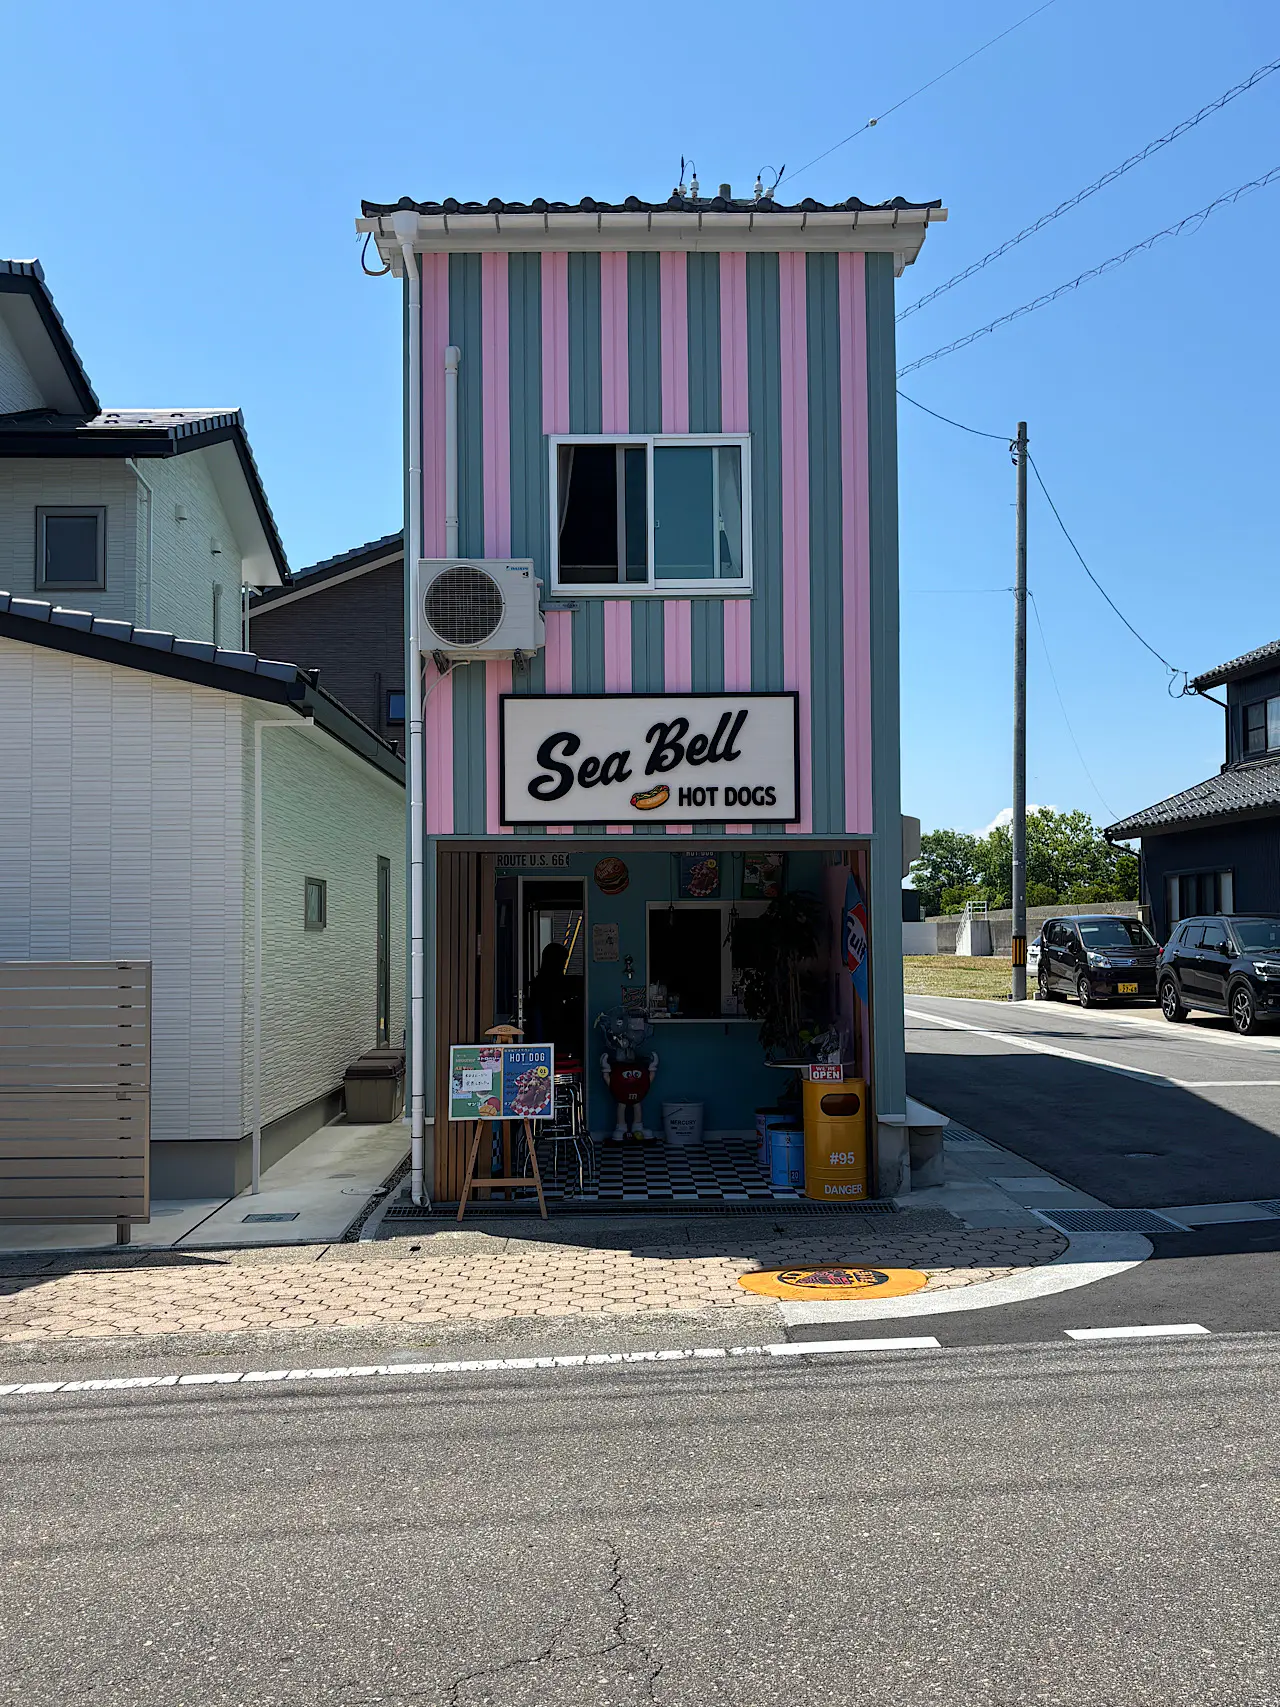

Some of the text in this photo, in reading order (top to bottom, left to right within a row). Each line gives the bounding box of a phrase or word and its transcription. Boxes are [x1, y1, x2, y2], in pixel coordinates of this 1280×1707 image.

[528, 710, 748, 801] Sea Bell
[678, 786, 776, 807] HOT DOGS
[497, 855, 526, 866] ROUTE
[530, 855, 549, 866] U.S.
[510, 1052, 545, 1062] HOT DOG
[812, 1071, 840, 1079] OPEN
[829, 1151, 855, 1165] #95
[824, 1183, 863, 1195] DANGER
